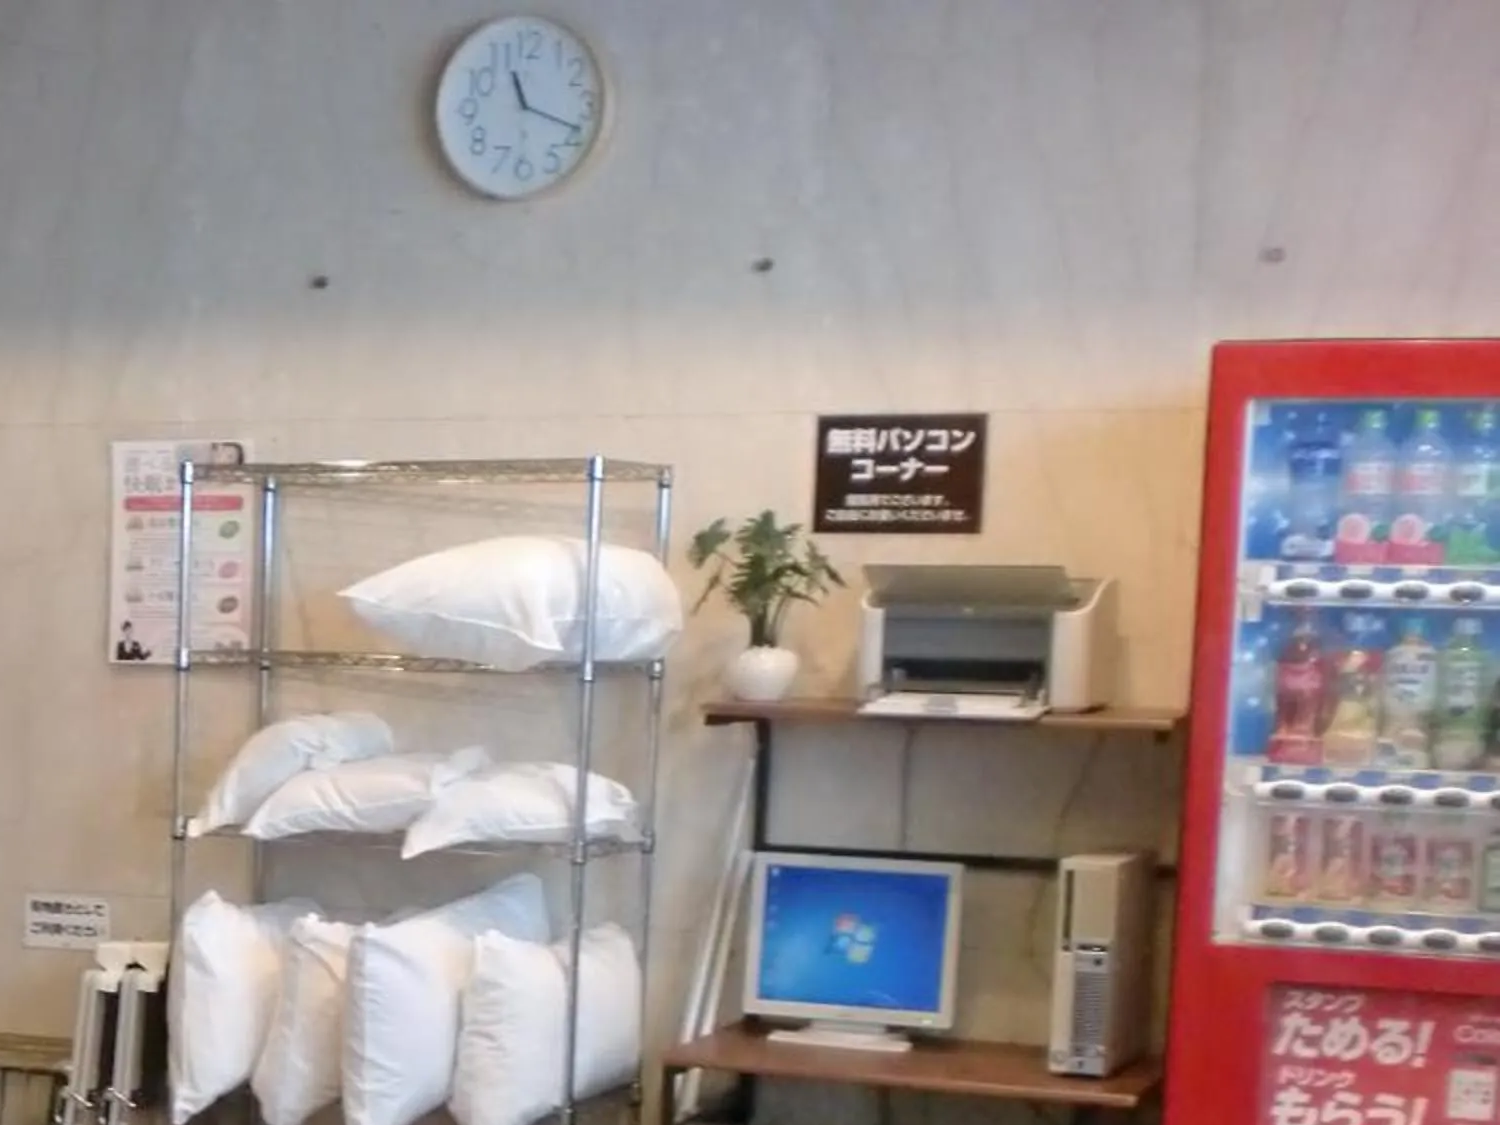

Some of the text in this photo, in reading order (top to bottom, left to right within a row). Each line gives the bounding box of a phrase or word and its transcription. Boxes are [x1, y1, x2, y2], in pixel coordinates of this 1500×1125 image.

[489, 42, 511, 70] 11
[517, 30, 542, 60] 12
[468, 65, 494, 97] 10
[567, 57, 583, 87] 2
[458, 97, 478, 126] 9
[469, 125, 487, 156] 8
[491, 145, 512, 174] 7
[514, 154, 534, 181] 6
[826, 427, 976, 454] 無料パソコン
[850, 457, 950, 481] コーナー
